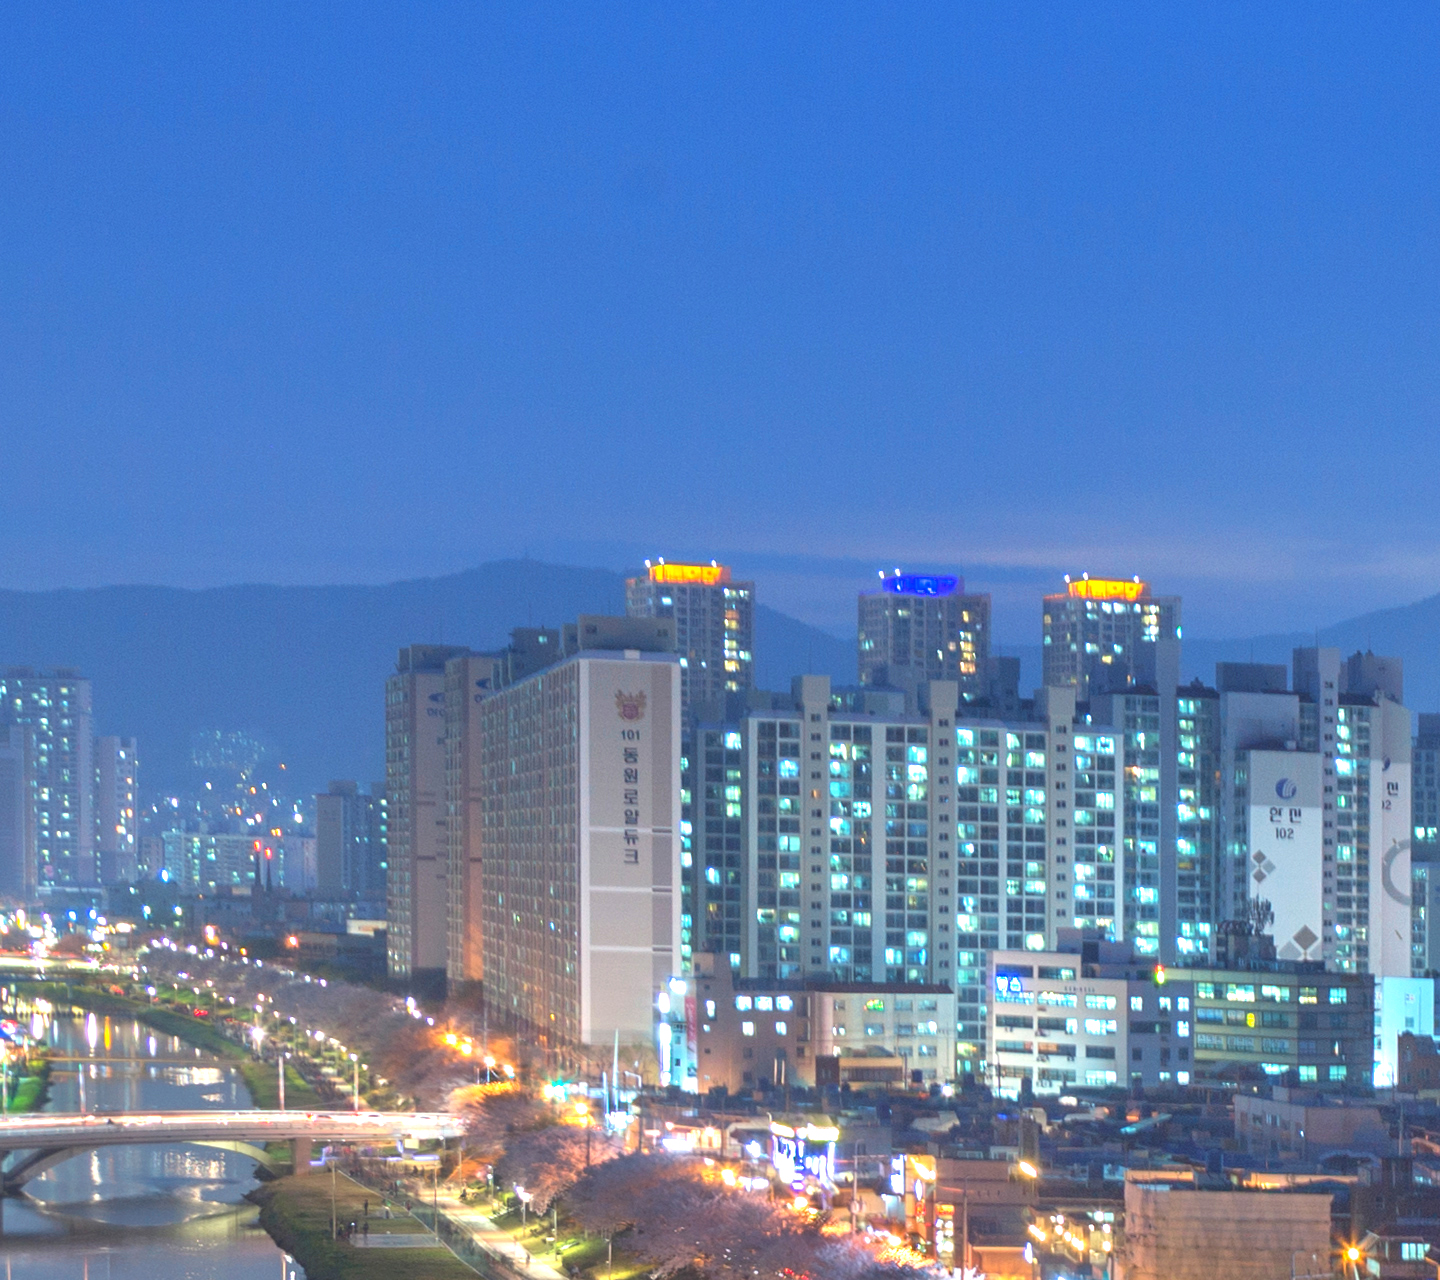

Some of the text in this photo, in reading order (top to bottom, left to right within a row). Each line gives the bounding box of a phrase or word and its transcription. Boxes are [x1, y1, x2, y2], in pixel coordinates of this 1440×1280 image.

[621, 729, 641, 741] 101
[623, 747, 639, 865] 동원로얄듀크
[1275, 827, 1294, 840] 102
